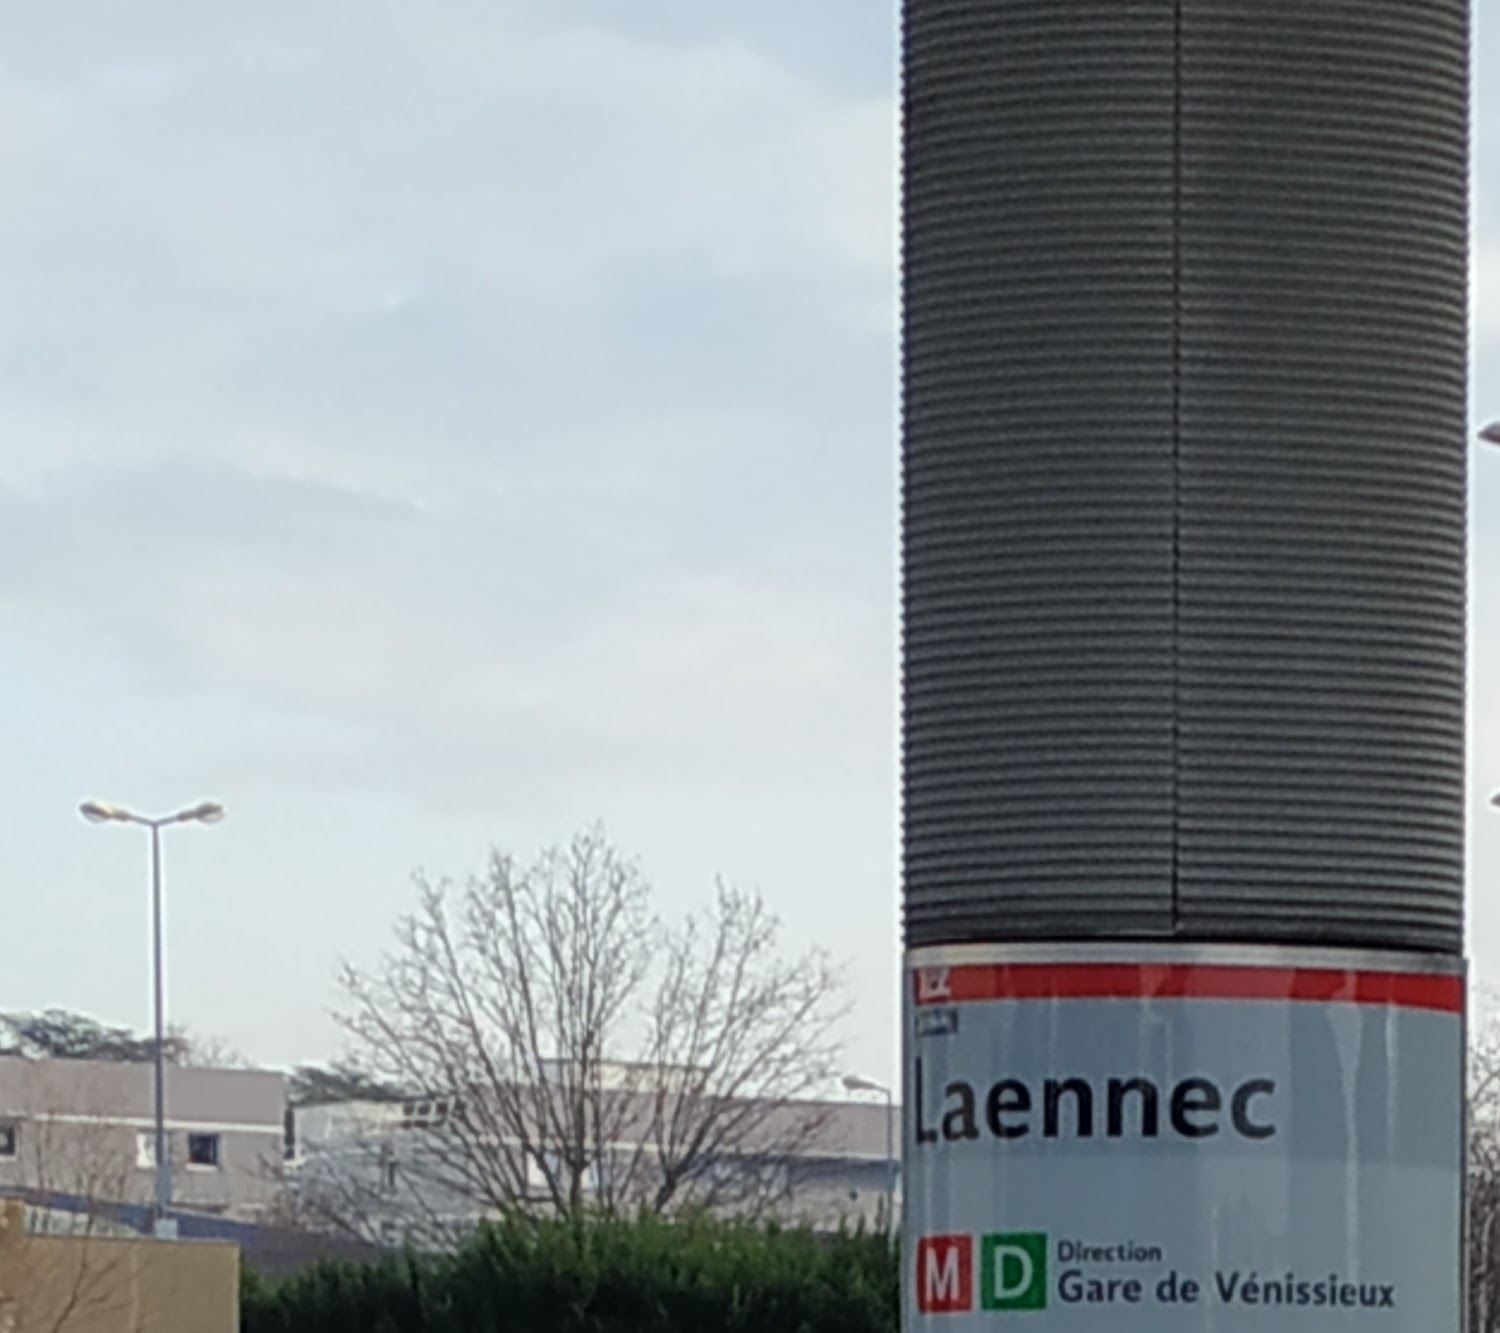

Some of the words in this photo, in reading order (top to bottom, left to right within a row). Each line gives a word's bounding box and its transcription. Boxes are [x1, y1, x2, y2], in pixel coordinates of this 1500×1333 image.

[914, 1056, 1278, 1146] Laennec
[924, 1246, 962, 1301] M
[992, 1244, 1034, 1300] D
[1056, 1240, 1163, 1264] Direction
[1057, 1270, 1142, 1304] Gare
[1155, 1270, 1200, 1304] de
[1214, 1270, 1395, 1309] Vénissieux
